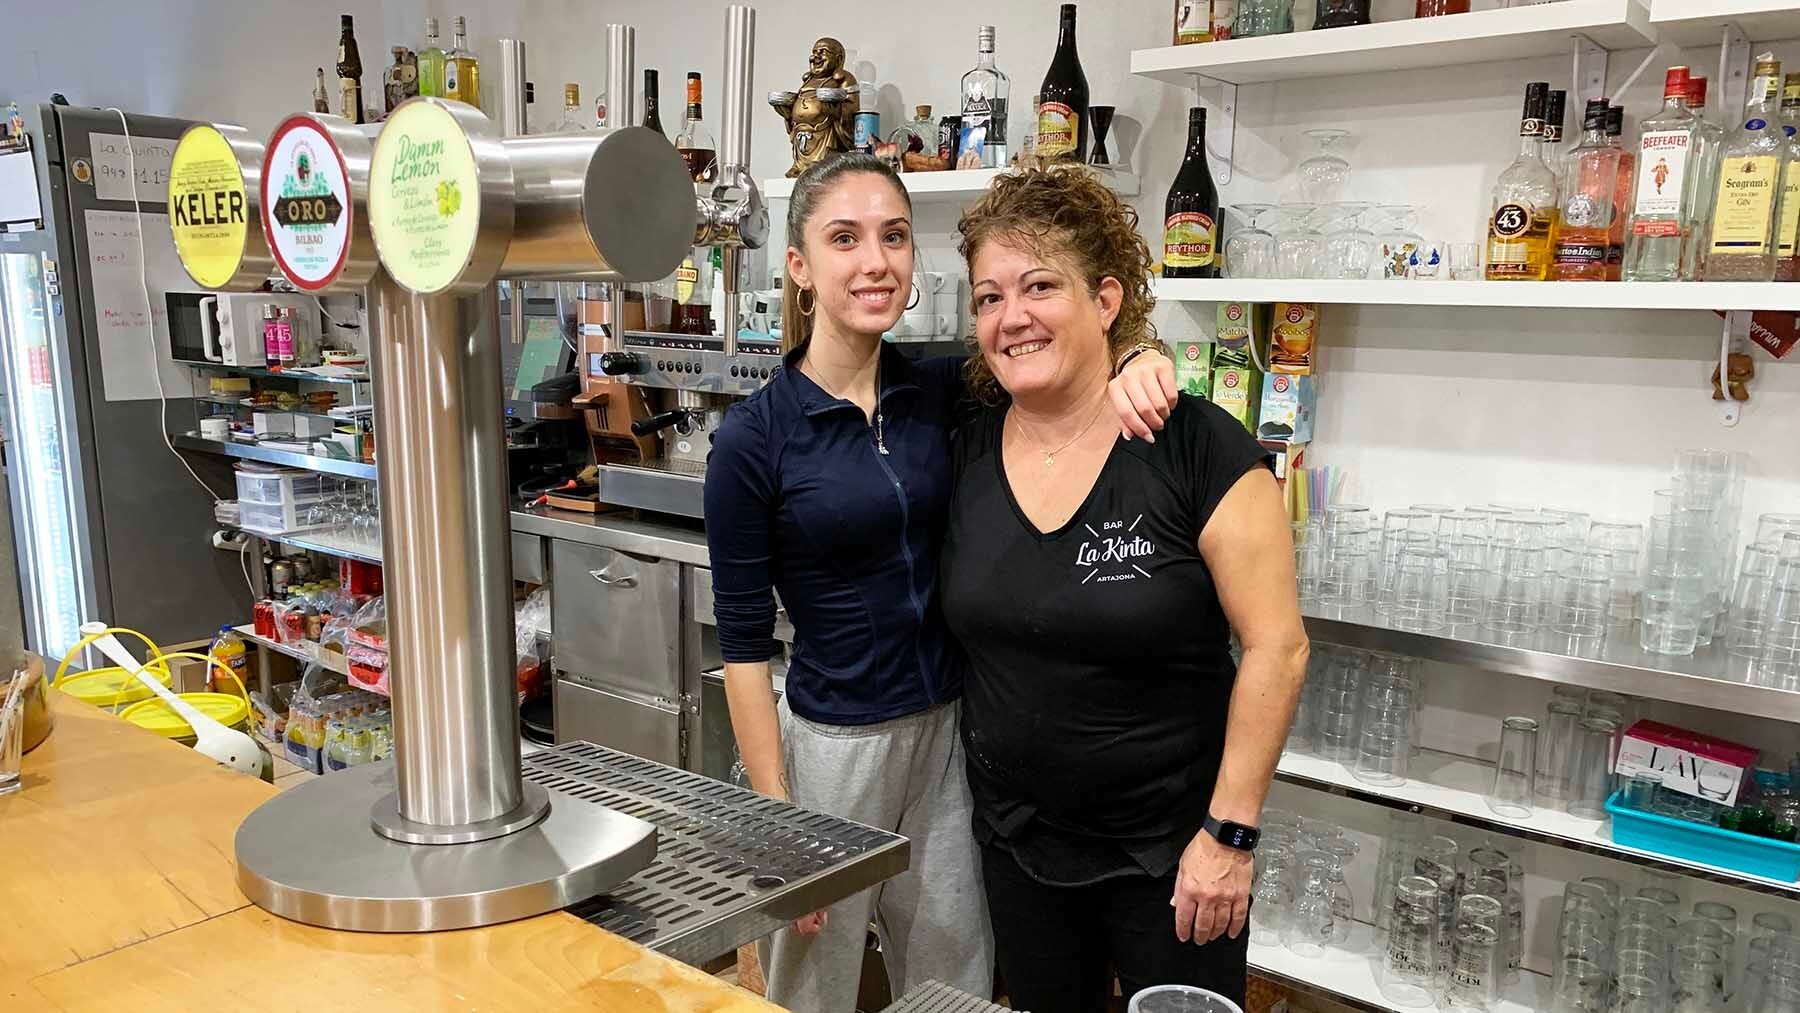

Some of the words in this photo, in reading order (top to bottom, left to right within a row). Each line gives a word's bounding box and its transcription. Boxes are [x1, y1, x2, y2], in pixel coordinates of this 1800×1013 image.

[399, 134, 444, 164] Damm
[1643, 135, 1688, 149] BEEFEATER
[391, 154, 441, 184] Lemon
[1726, 178, 1768, 190] Seagram's
[173, 190, 244, 227] KELER
[288, 199, 327, 222] ORO
[1497, 210, 1521, 228] 43
[1167, 244, 1207, 253] REYTHOR
[1103, 520, 1123, 530] BAR
[1075, 542, 1101, 566] La
[1101, 535, 1155, 563] Kinta
[1096, 573, 1136, 582] ARTAJONA
